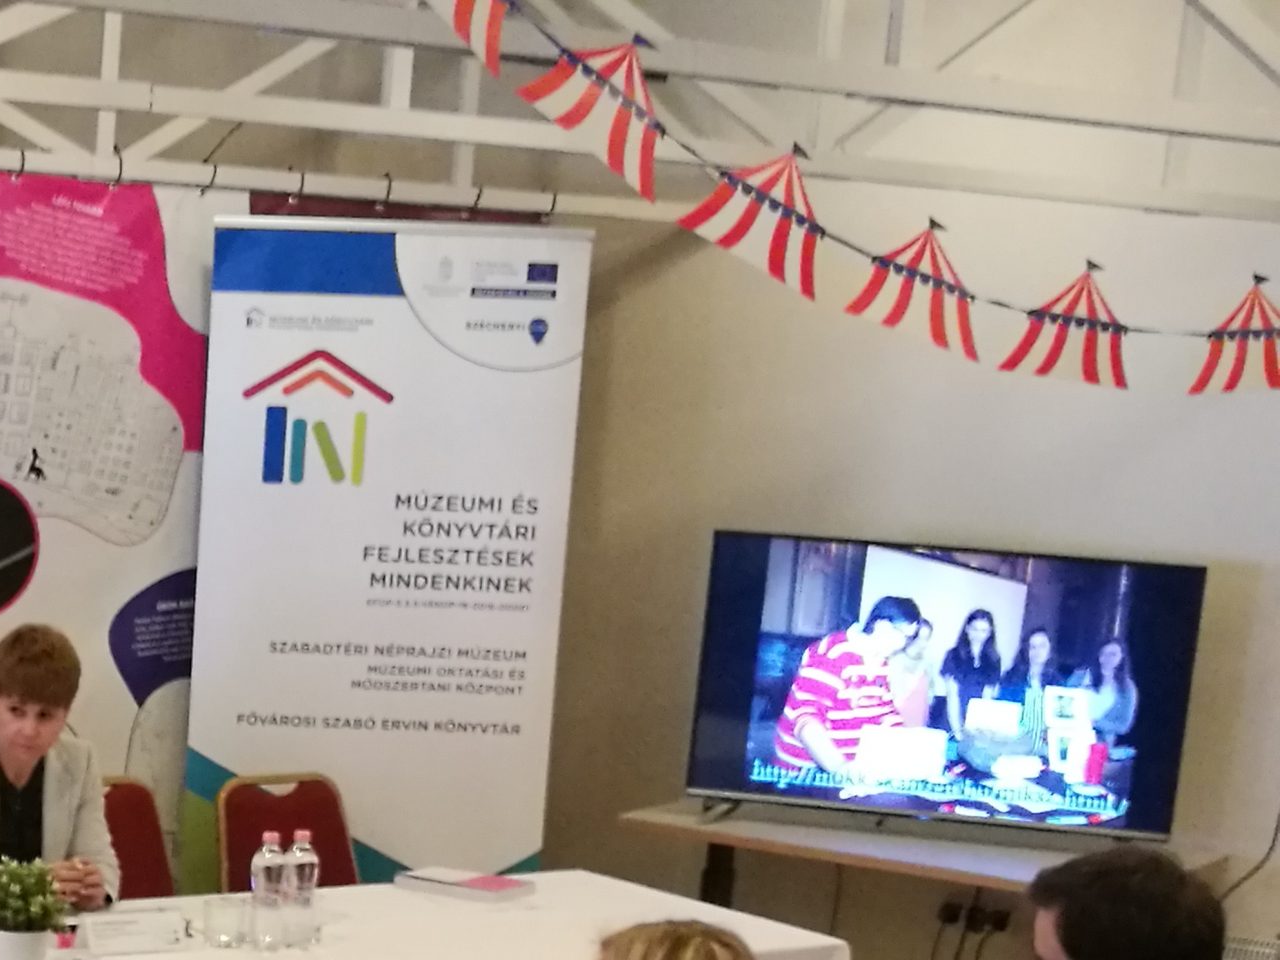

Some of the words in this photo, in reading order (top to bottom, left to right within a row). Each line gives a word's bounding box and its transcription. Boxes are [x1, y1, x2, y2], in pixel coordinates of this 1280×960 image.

[394, 490, 503, 514] MÚZEUMI
[511, 492, 539, 516] ÉS
[402, 518, 537, 541] KÖNYVTÁRI
[362, 543, 535, 568] FEJLESZTÉSEK
[369, 572, 533, 594] MINDENKINEK
[269, 640, 369, 657] SZABADTÉRI
[374, 643, 452, 659] NÉPRAJZI
[456, 645, 527, 662] MÚZEUM
[435, 664, 504, 680] OKTATÁSI
[508, 667, 526, 681] ÉS
[350, 677, 451, 693] MÓDSZERTANI
[455, 681, 523, 696] KÖZPONT
[236, 710, 317, 727] FŐVÁROSI
[321, 713, 377, 730] SZABÓ
[380, 718, 430, 732] ERVIN
[433, 717, 522, 736] KÖNYVTÁR
